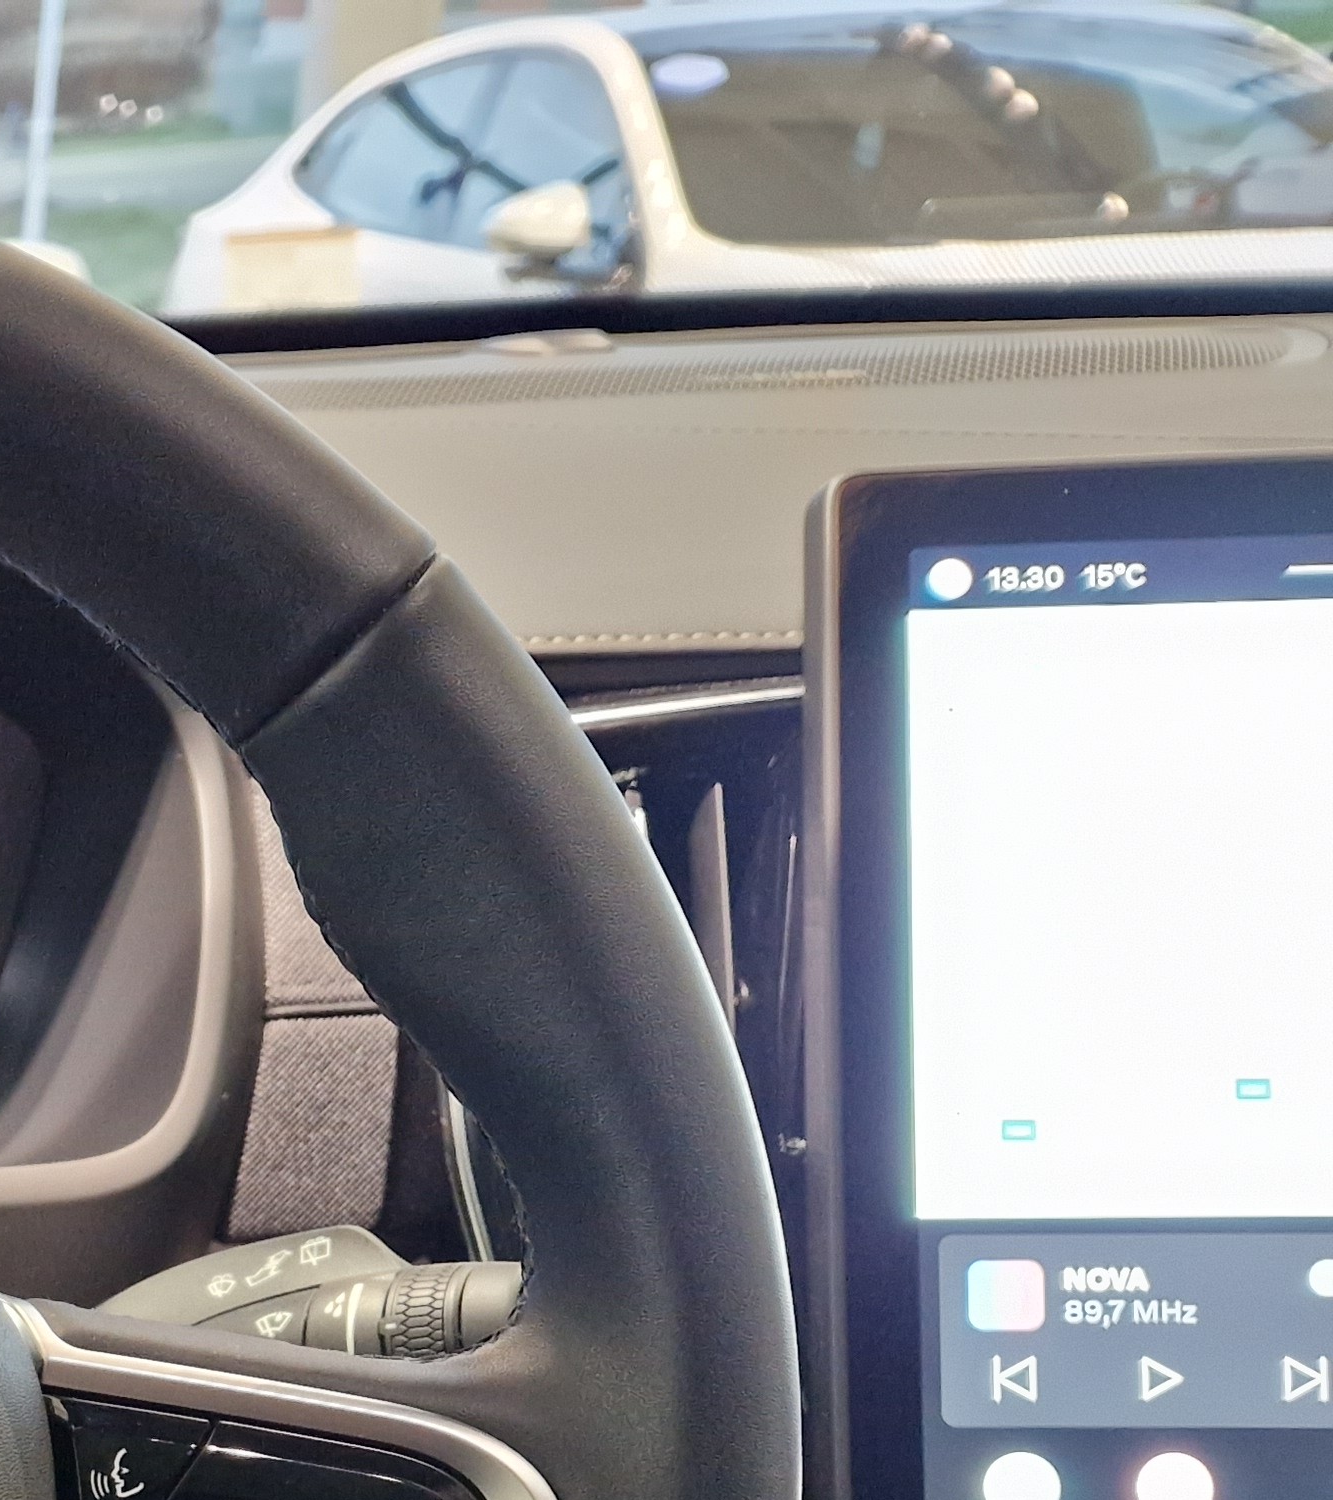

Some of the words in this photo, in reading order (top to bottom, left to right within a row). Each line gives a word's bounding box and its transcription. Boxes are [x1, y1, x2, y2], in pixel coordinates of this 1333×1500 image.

[988, 564, 1065, 592] 13.30
[1082, 561, 1148, 590] 15°C
[1061, 1266, 1150, 1292] NOVA
[1063, 1299, 1126, 1329] 89,7
[1132, 1301, 1198, 1325] MHz
